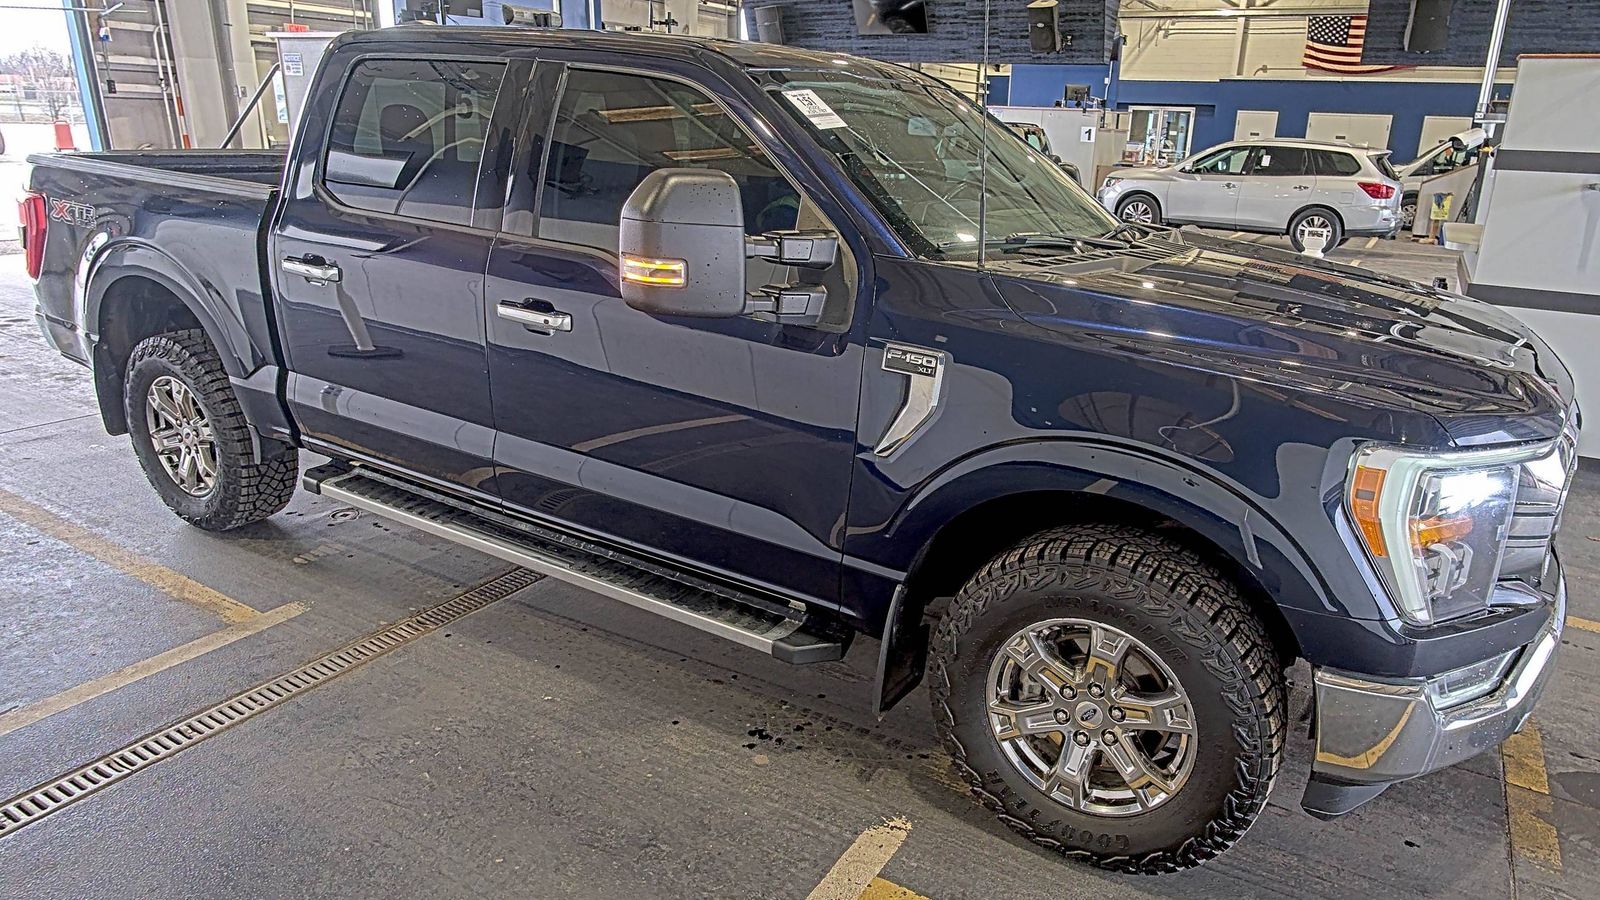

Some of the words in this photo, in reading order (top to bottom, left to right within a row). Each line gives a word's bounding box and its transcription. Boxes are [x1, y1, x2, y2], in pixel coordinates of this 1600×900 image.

[1085, 128, 1092, 141] 1
[887, 350, 936, 368] F-150
[918, 366, 933, 375] XLT
